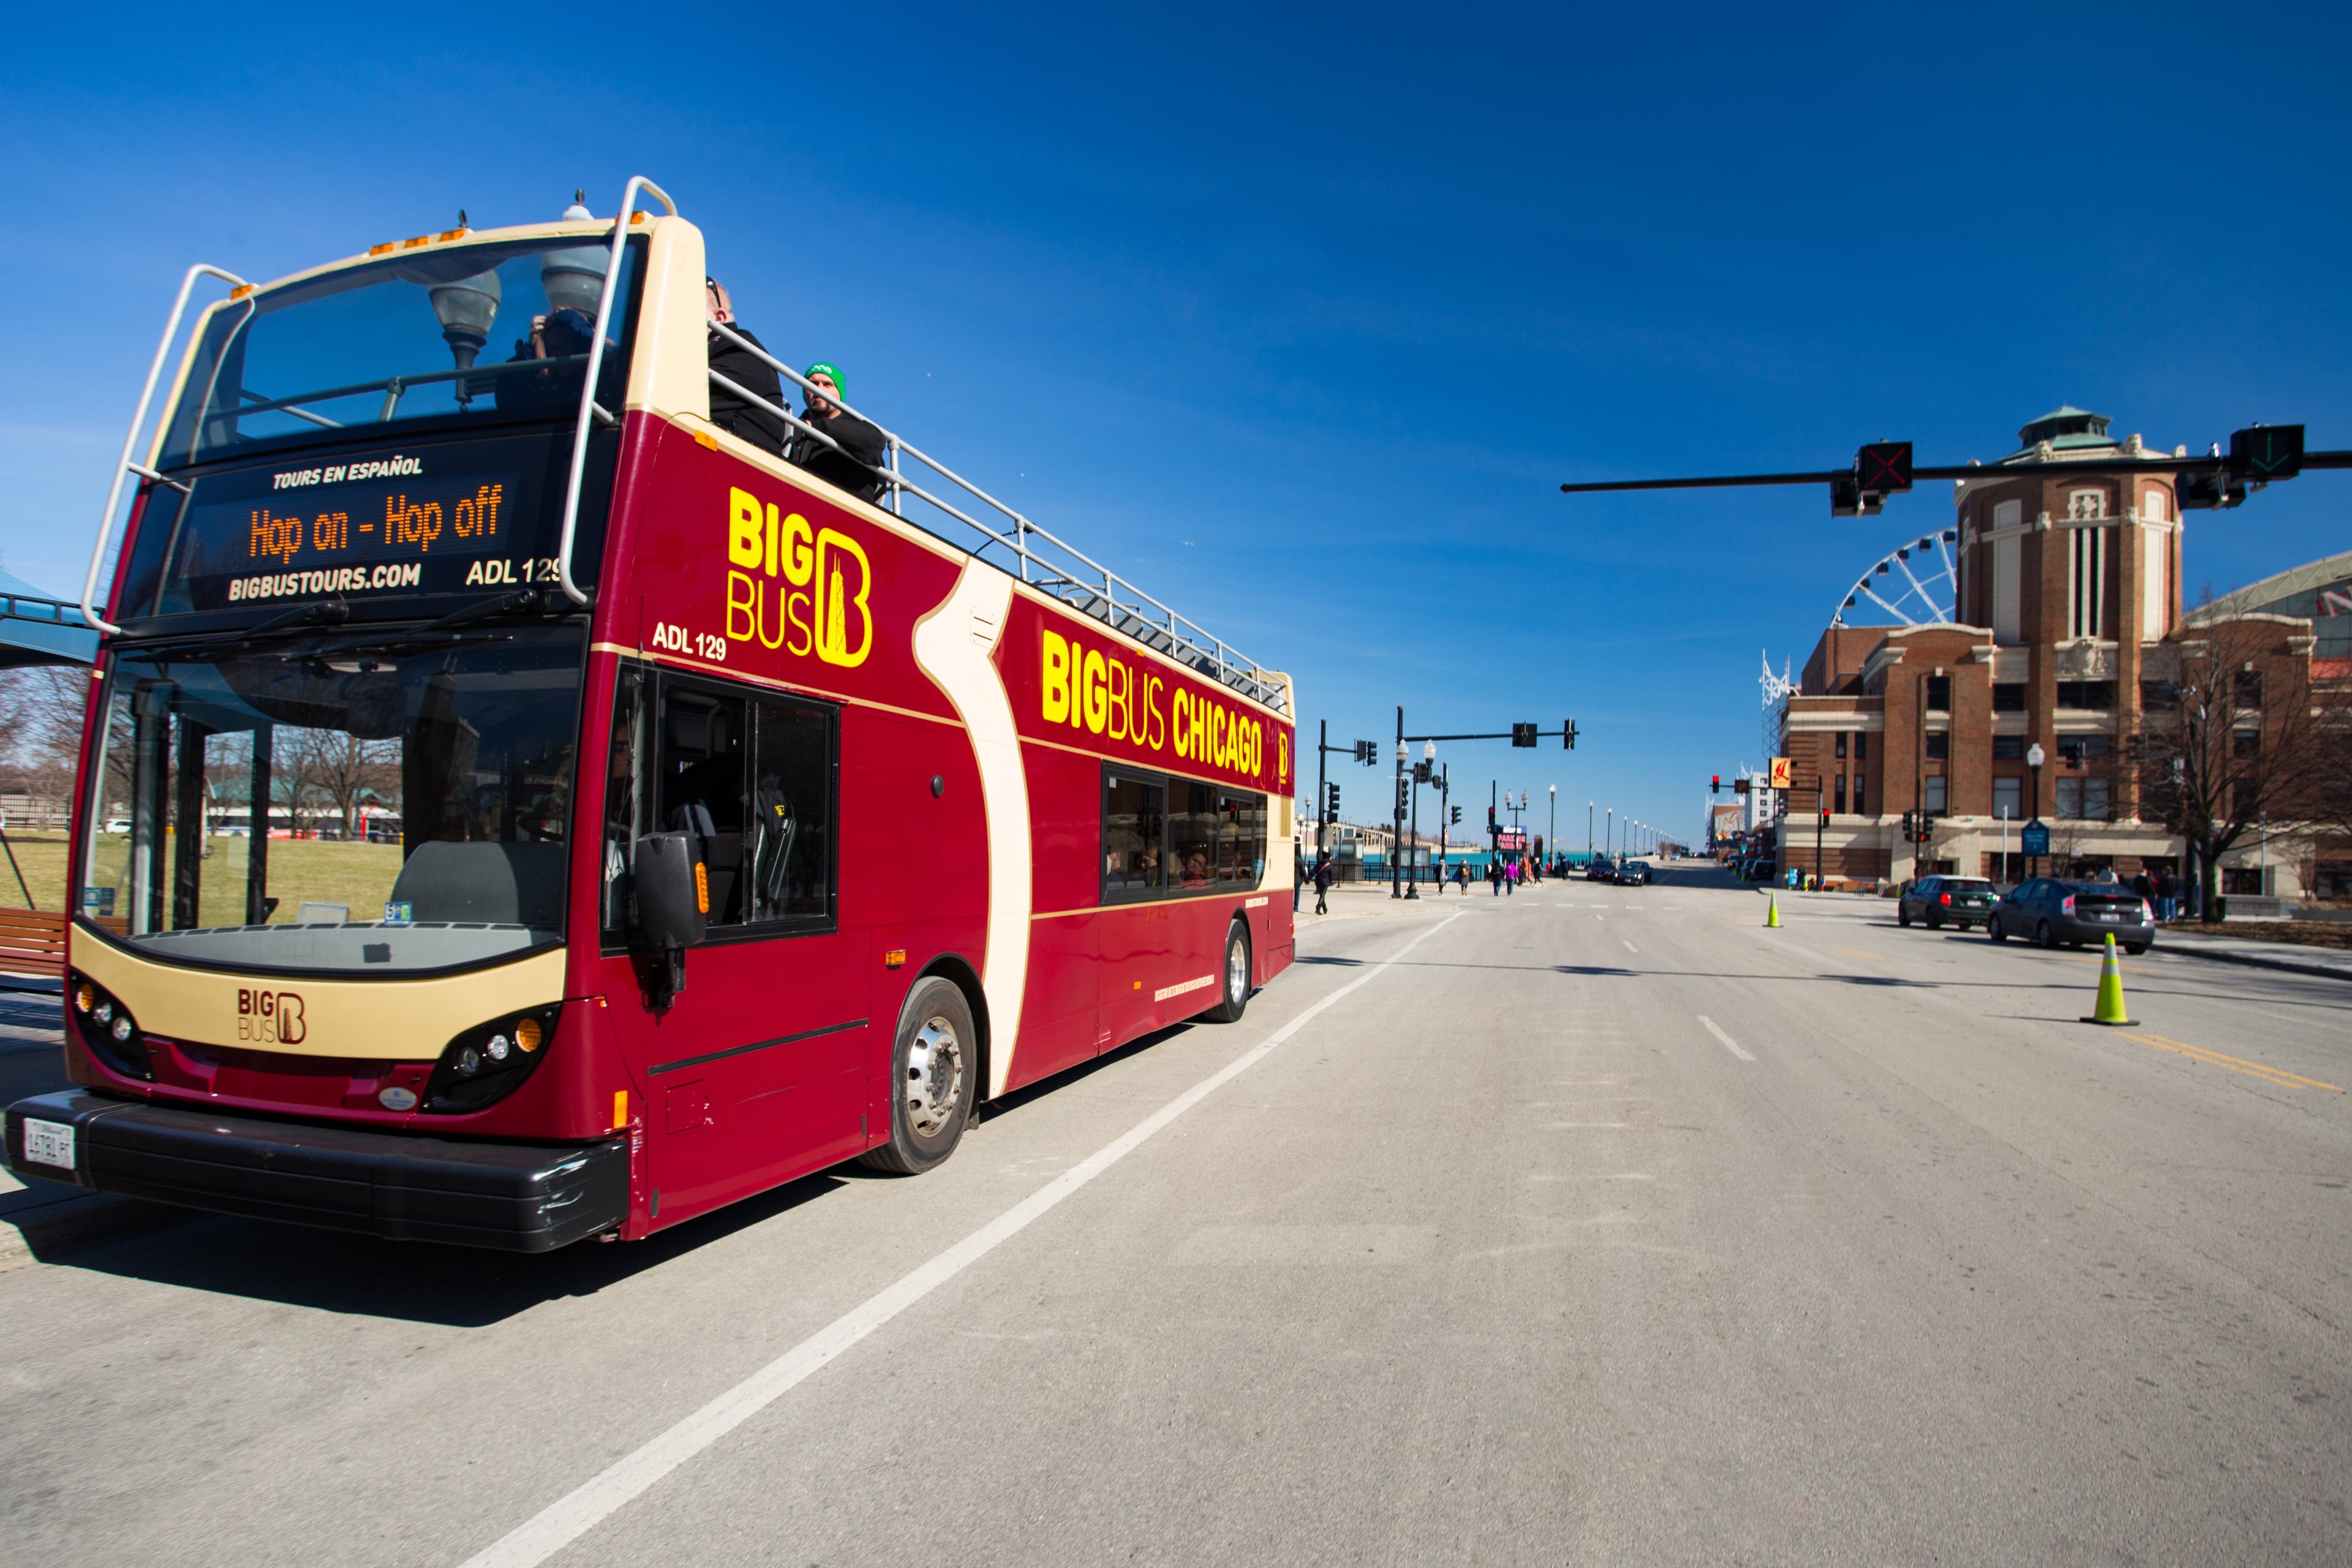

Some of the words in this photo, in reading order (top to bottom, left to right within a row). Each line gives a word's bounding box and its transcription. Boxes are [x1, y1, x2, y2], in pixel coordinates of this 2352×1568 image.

[274, 469, 322, 489] TOURS
[323, 466, 347, 484] EN
[347, 455, 423, 480] ESPAÑOL
[251, 510, 302, 564] Hop
[313, 512, 348, 551] on
[385, 496, 442, 552] Hop
[455, 484, 502, 537] off
[728, 486, 813, 586] BIG
[228, 563, 421, 601] BIGBUSTOURS.COM
[466, 559, 518, 586] ADL
[726, 570, 812, 657] BUS
[652, 622, 693, 654] ADL
[695, 633, 726, 661] 129
[1173, 687, 1262, 777] CHICAGO
[1498, 834, 1526, 843] PARKNG
[238, 989, 274, 1017] BIG
[238, 1017, 276, 1043] BUS
